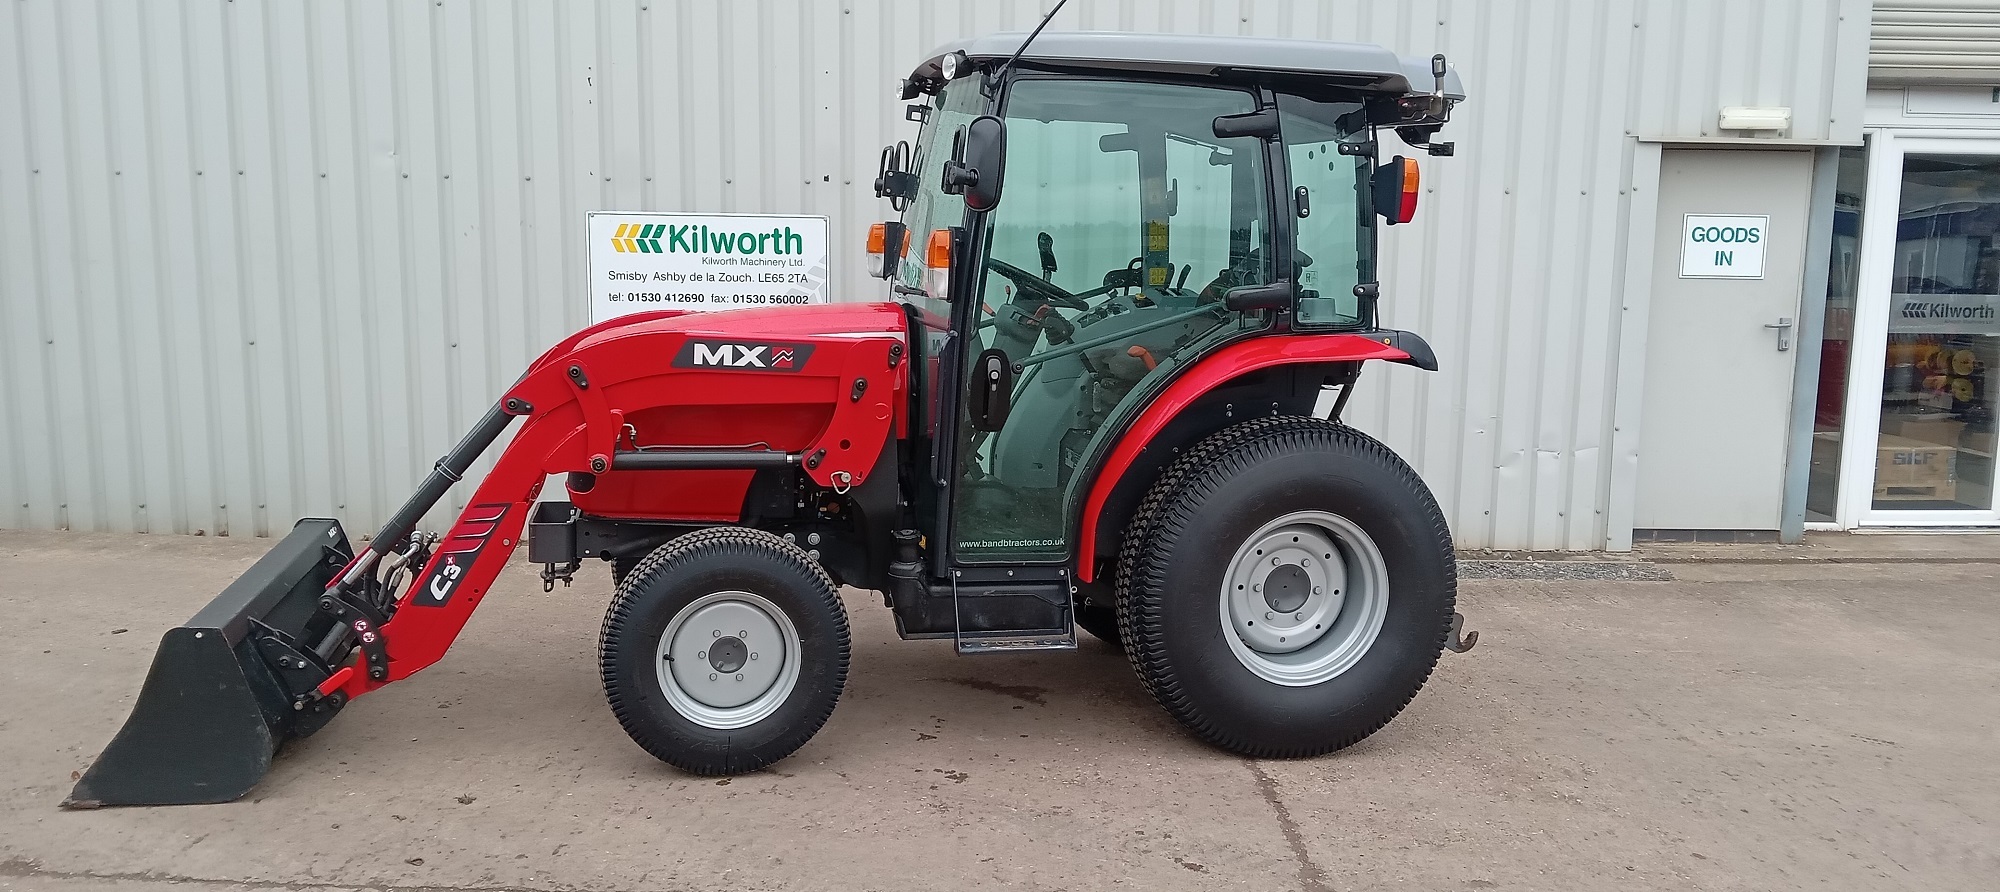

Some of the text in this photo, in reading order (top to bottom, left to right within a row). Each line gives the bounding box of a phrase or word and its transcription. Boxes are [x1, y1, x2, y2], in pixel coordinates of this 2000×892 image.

[669, 224, 803, 255] Kilworth
[1691, 226, 1760, 243] GOODS
[701, 257, 806, 268] Kilworth Machinery Ltd.
[1714, 250, 1733, 266] IN
[608, 270, 809, 284] Smisby Ashby de la Zouch. LE65 2TA
[608, 292, 809, 304] tel: 01530 412690 fax: 01530 560002
[1929, 303, 1995, 319] Kilworth
[693, 343, 769, 368] MX
[959, 537, 1065, 548] www.bandbtractors.co.uk
